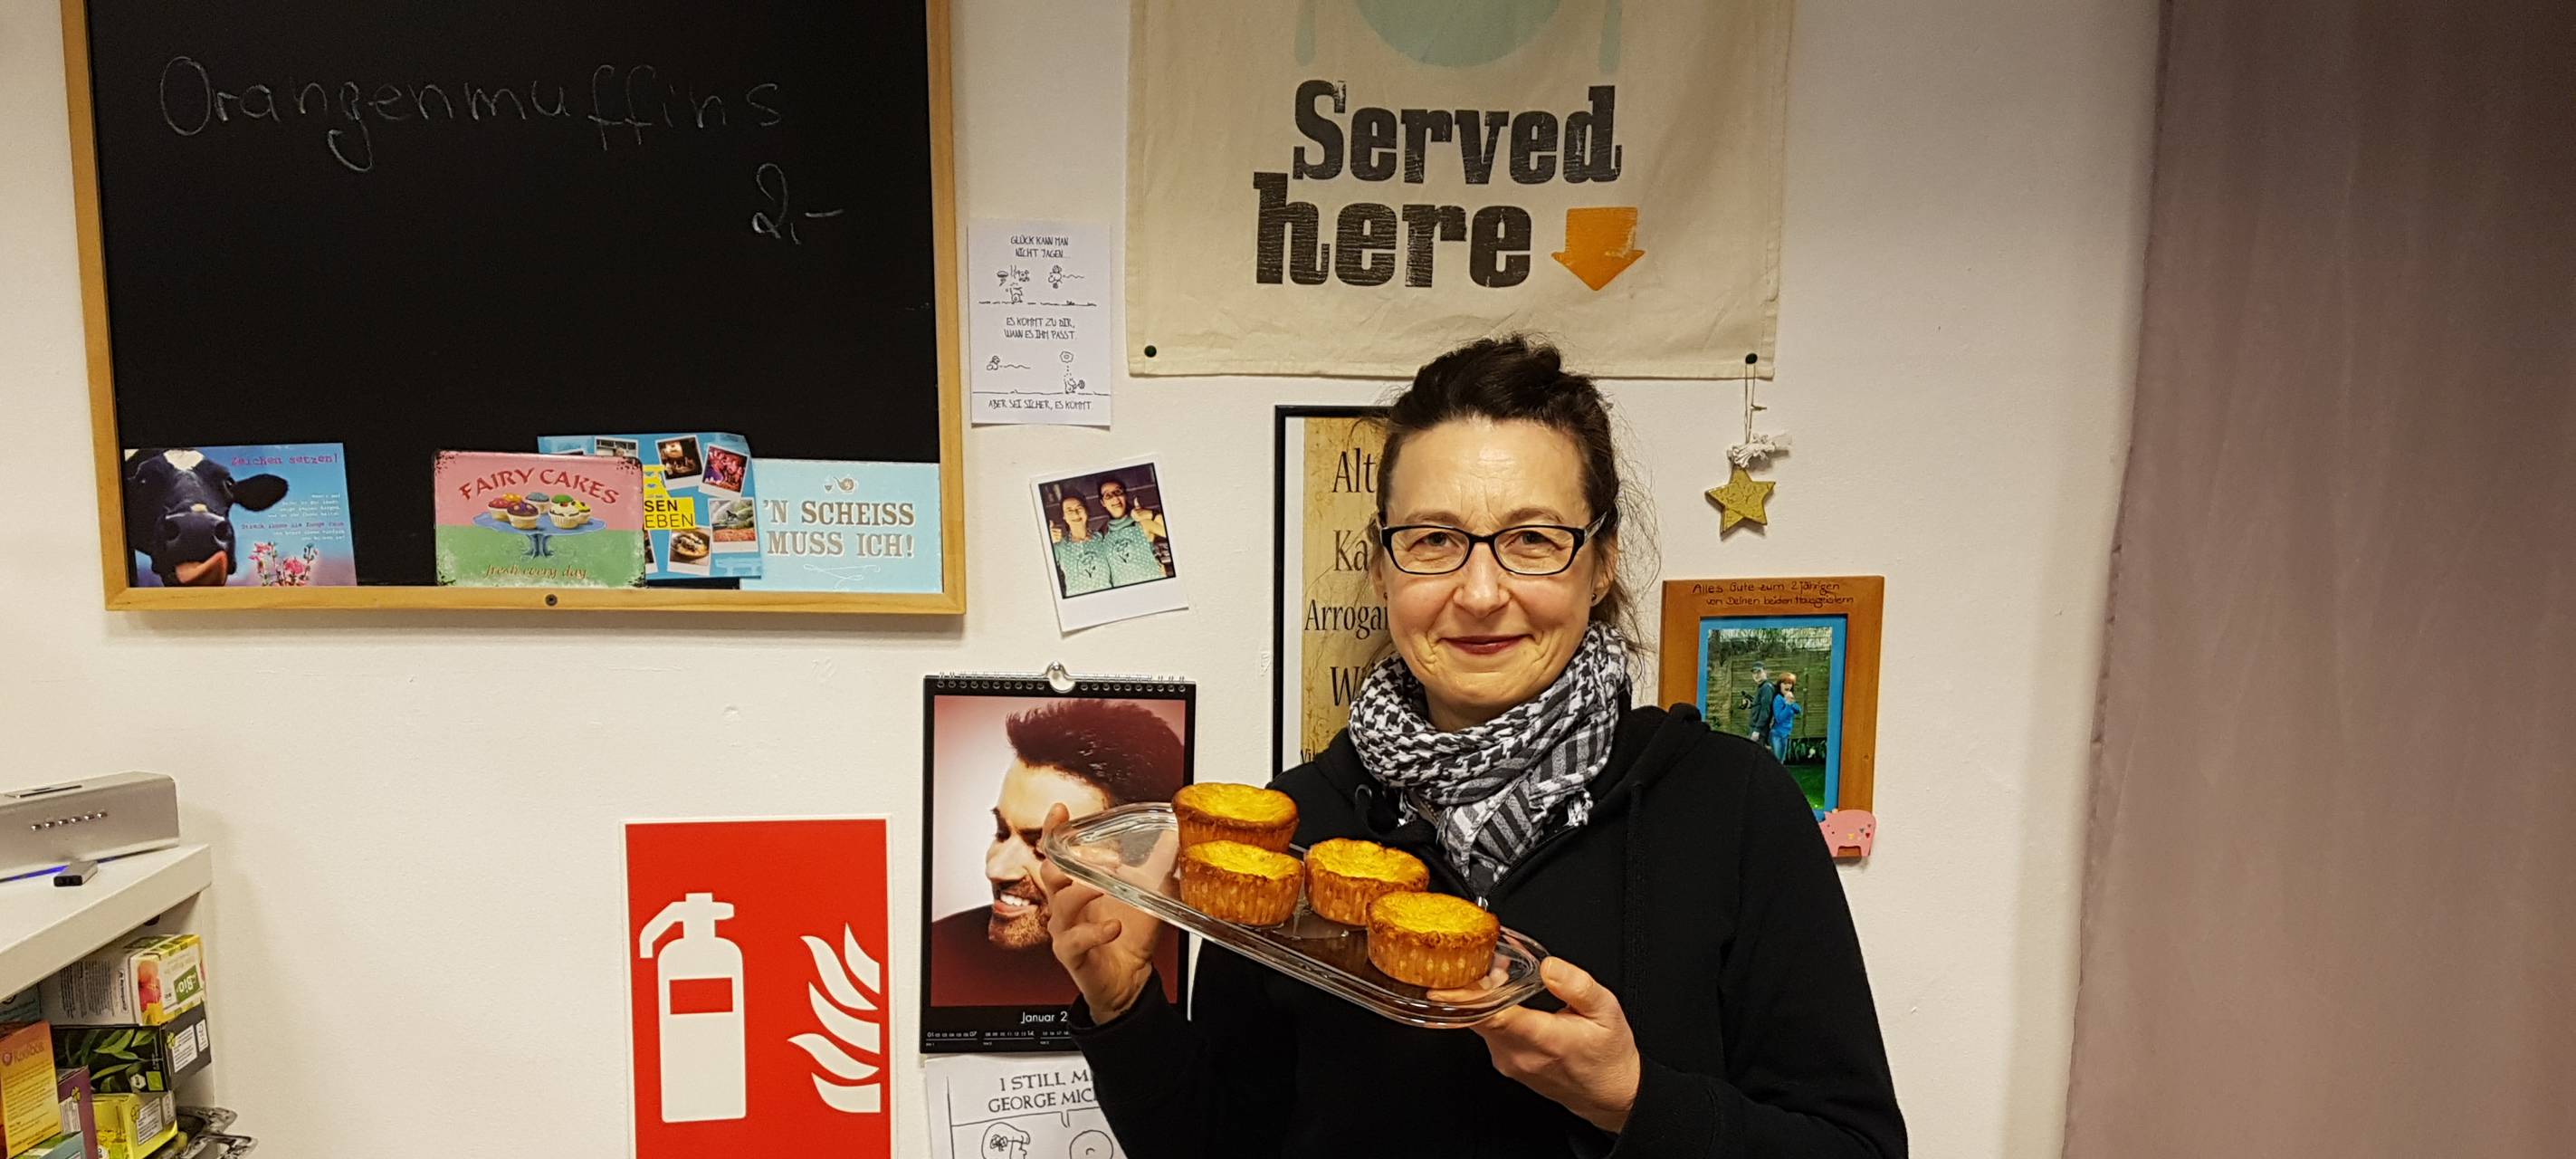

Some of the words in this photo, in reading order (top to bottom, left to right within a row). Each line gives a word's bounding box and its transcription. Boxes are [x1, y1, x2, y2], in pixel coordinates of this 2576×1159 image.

[159, 56, 785, 172] Orangenmuffins
[1293, 79, 1622, 185] Served
[1253, 172, 1531, 288] here
[1035, 235, 1053, 245] KANN
[1054, 236, 1069, 246] MAN
[1016, 247, 1038, 258] NICHT
[1006, 317, 1016, 326] ES
[1016, 317, 1044, 327] KOMMT
[1045, 318, 1057, 327] ZU
[1004, 329, 1024, 339] WANN
[1025, 330, 1034, 339] ES
[1035, 330, 1049, 340] IHM
[988, 399, 1007, 409] ABER
[1008, 399, 1023, 408] SEI
[1054, 400, 1064, 409] ES
[231, 455, 282, 466] Zeichen
[1331, 448, 1377, 493] Alt
[458, 467, 535, 501] FAIRY
[539, 468, 621, 504] CAKES
[800, 500, 915, 527] SCHEISS
[767, 531, 844, 556] MUSS
[855, 532, 914, 558] ICH!
[1693, 583, 1723, 594] Alles
[1730, 581, 1754, 592] Gute
[1758, 583, 1785, 591] zum
[1020, 1011, 1055, 1024] Januar
[1000, 1078, 1007, 1091] I
[1011, 1072, 1067, 1091] STILL
[988, 1092, 1057, 1113] GEORGE
[1062, 1087, 1096, 1105] MIC
